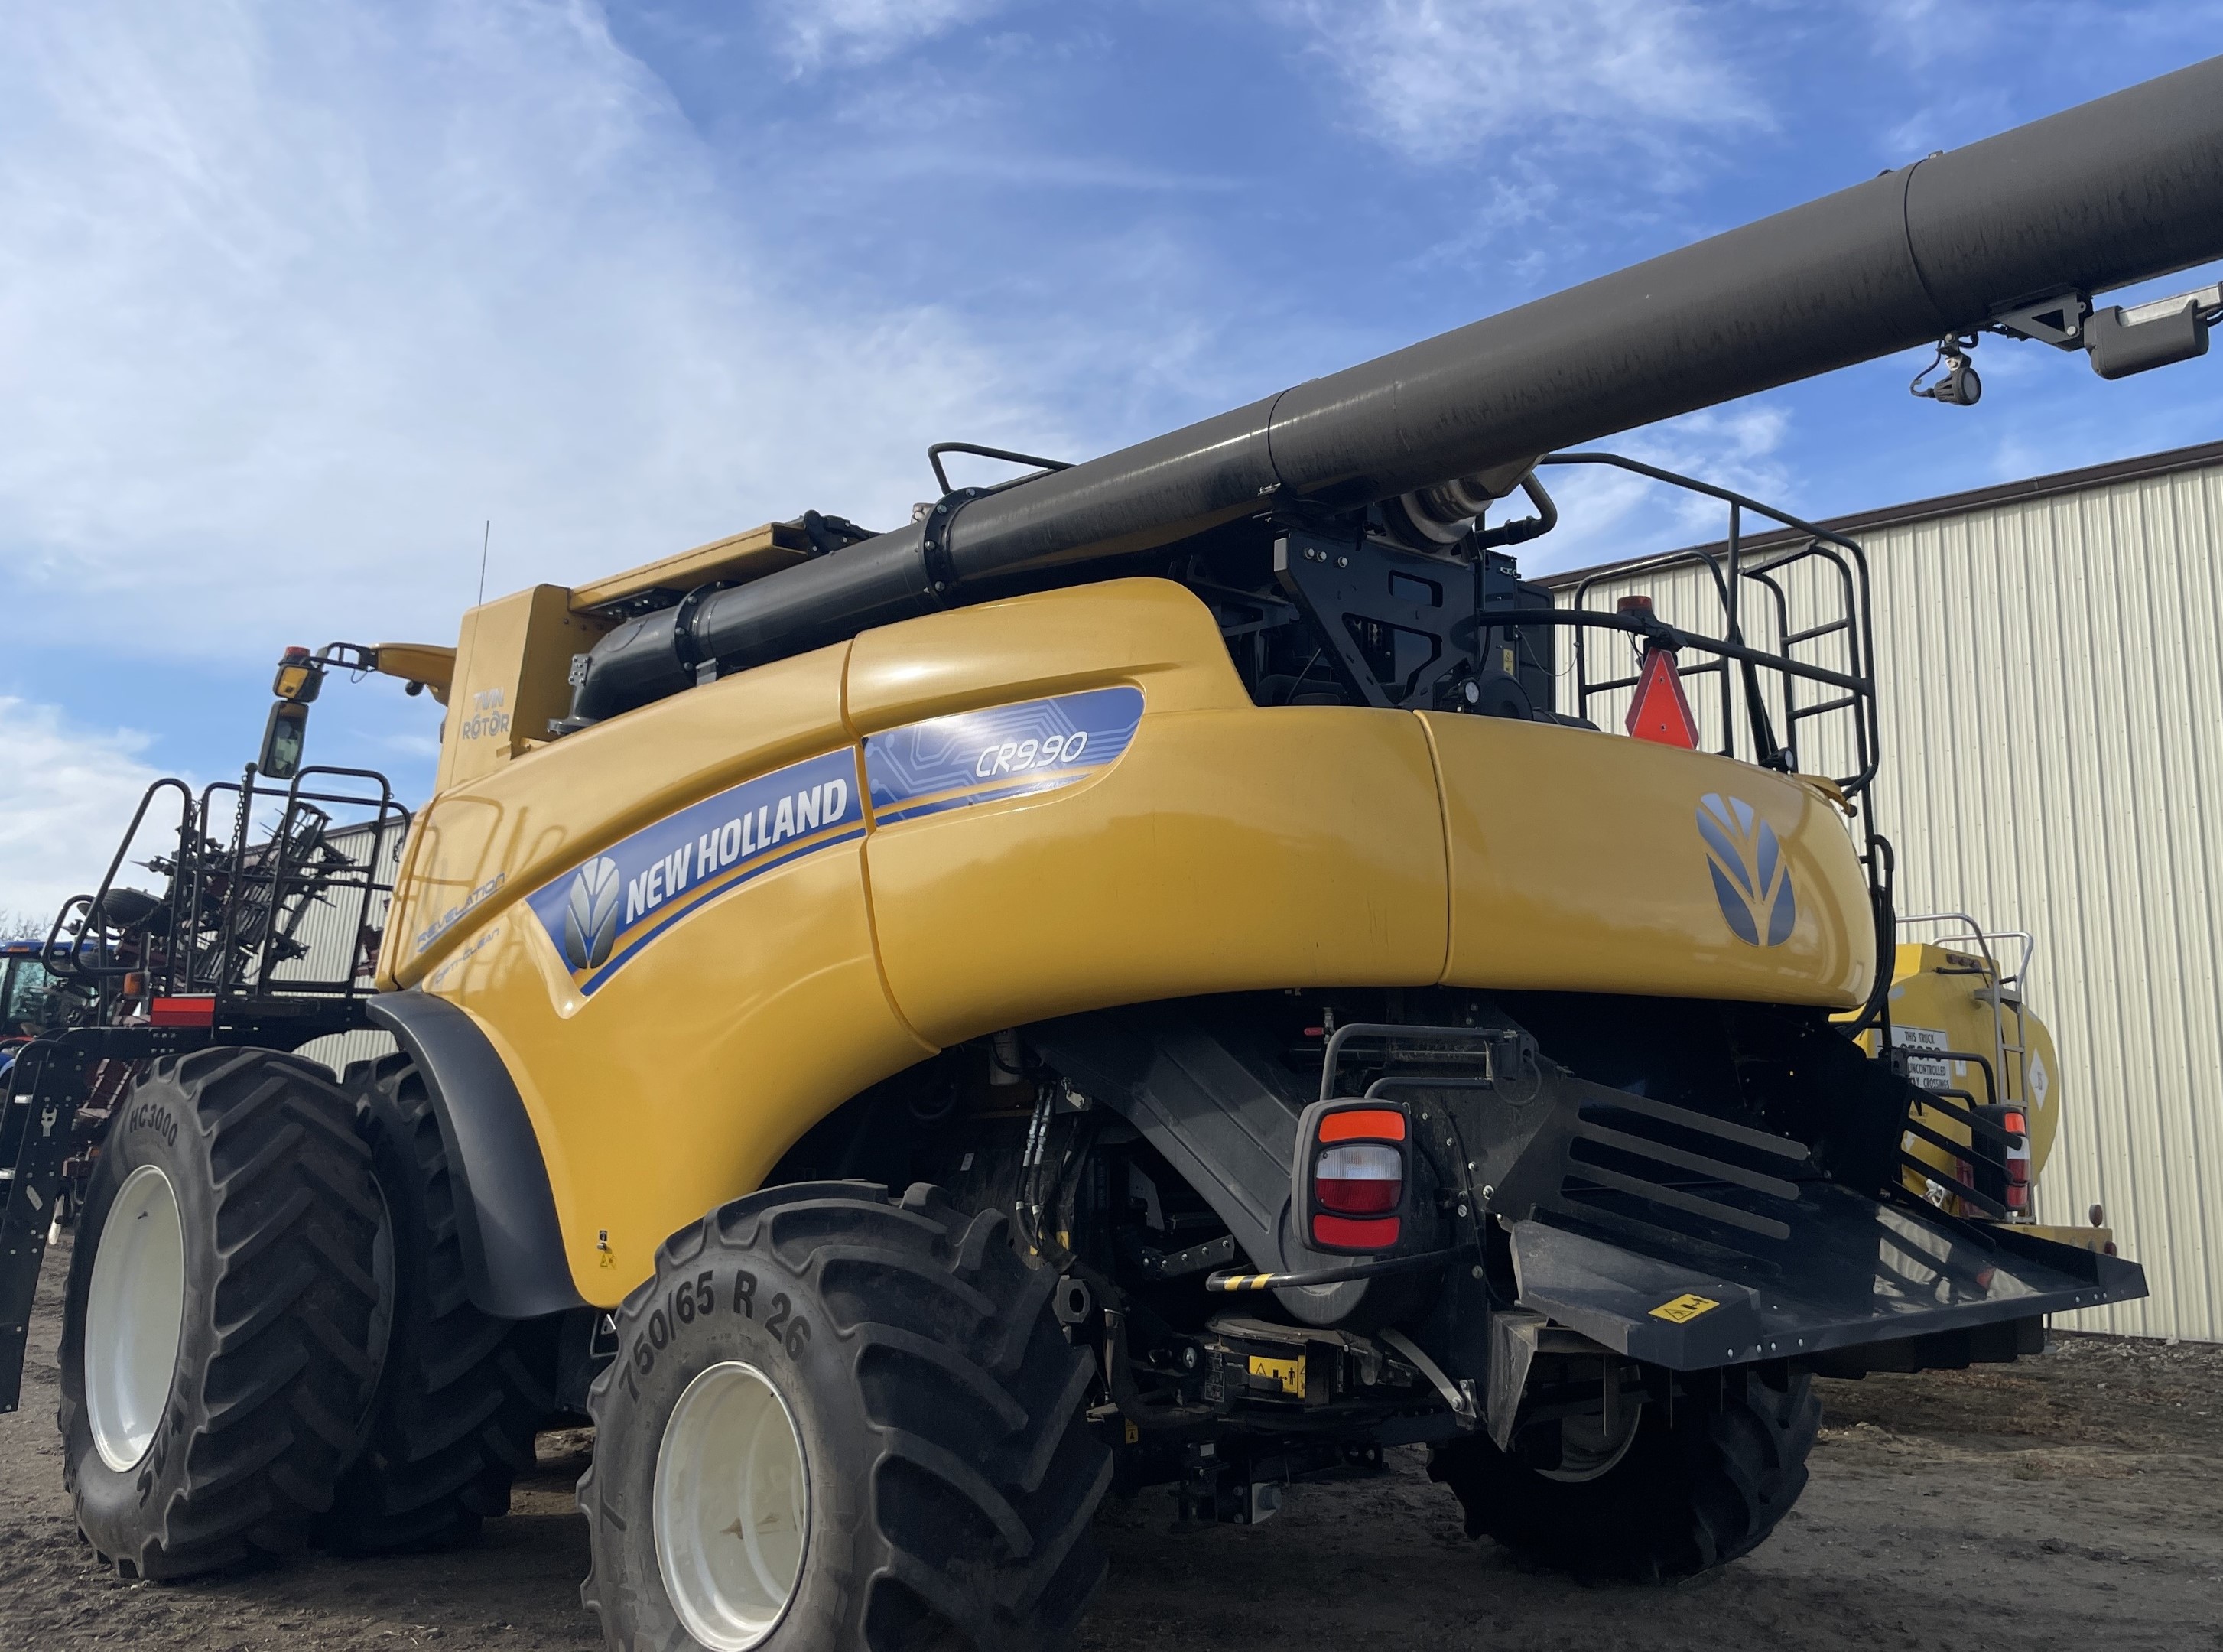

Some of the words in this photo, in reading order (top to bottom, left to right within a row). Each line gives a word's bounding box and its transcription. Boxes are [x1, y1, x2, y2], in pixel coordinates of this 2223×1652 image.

[473, 686, 505, 712] TWIN
[462, 710, 510, 740] ROTOR
[976, 731, 1088, 777] CR9.90
[626, 842, 693, 925] NEW
[697, 779, 847, 879] HOLLAND
[1904, 1031, 1916, 1042] THIS
[1918, 1032, 1935, 1045] TRUCK
[129, 1104, 178, 1147] HC3000
[618, 1270, 715, 1404] 750/65
[733, 1269, 758, 1319] R
[765, 1293, 811, 1353] 26
